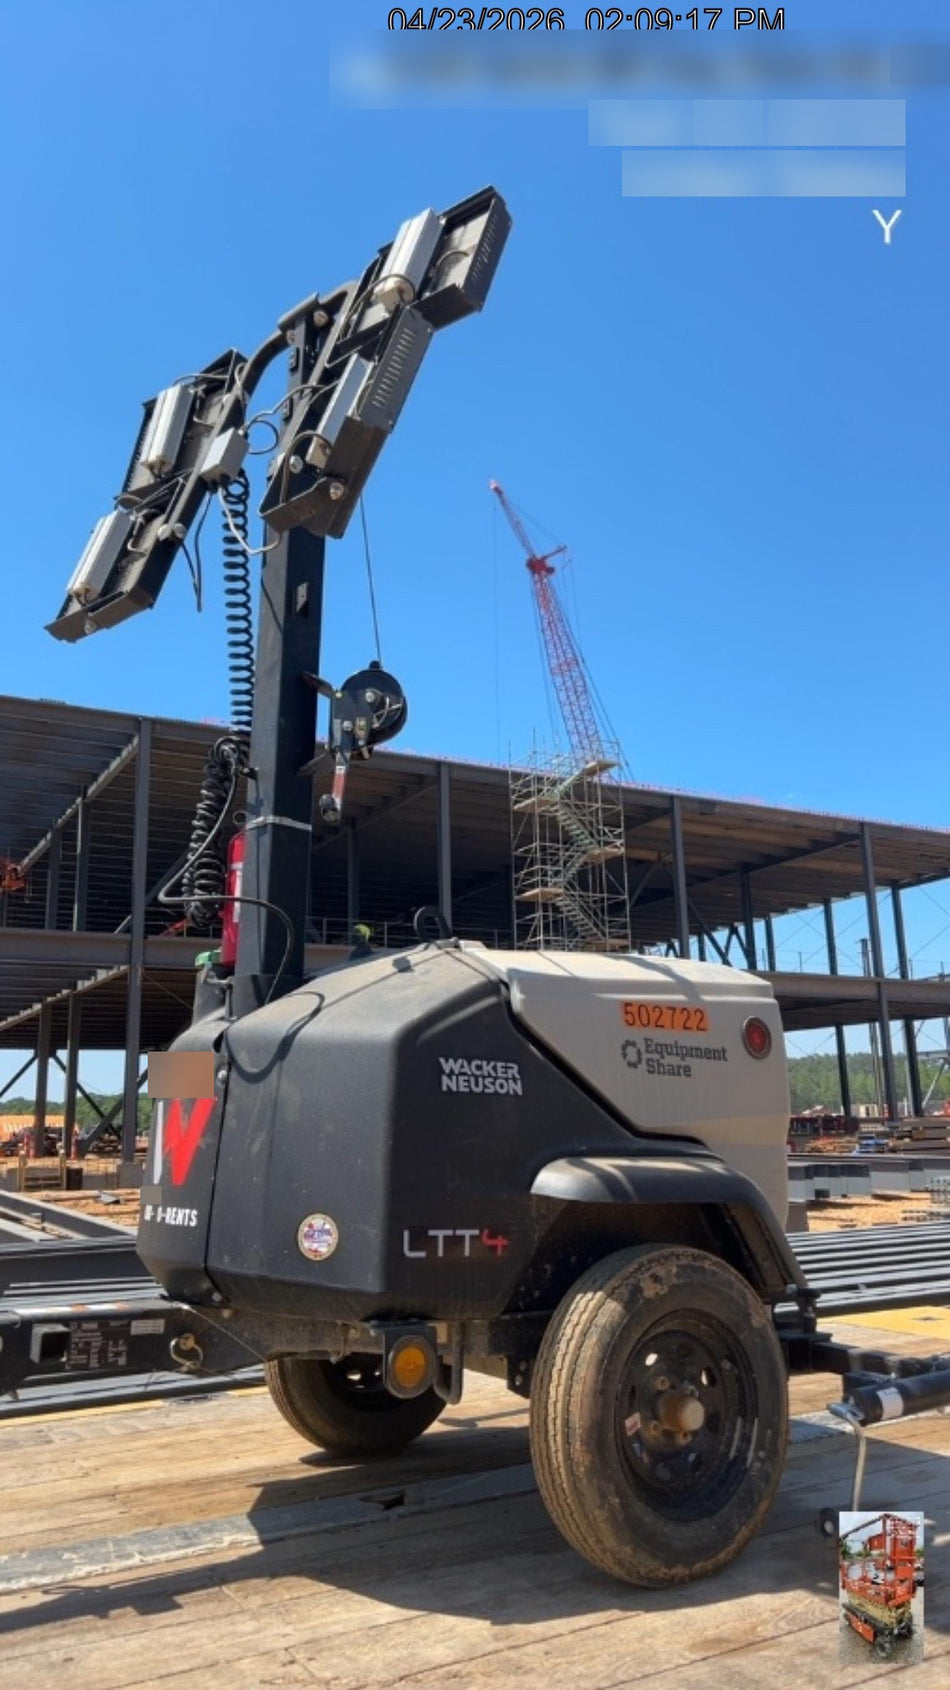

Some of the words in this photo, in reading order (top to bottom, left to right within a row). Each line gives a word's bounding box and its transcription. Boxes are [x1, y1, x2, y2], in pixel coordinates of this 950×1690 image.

[624, 1002, 707, 1032] 502722
[644, 1038, 728, 1062] Equipment
[439, 1056, 521, 1079] WACKER
[645, 1057, 692, 1078] Share
[441, 1074, 523, 1096] NEUSON
[403, 1228, 508, 1258] LTT4
